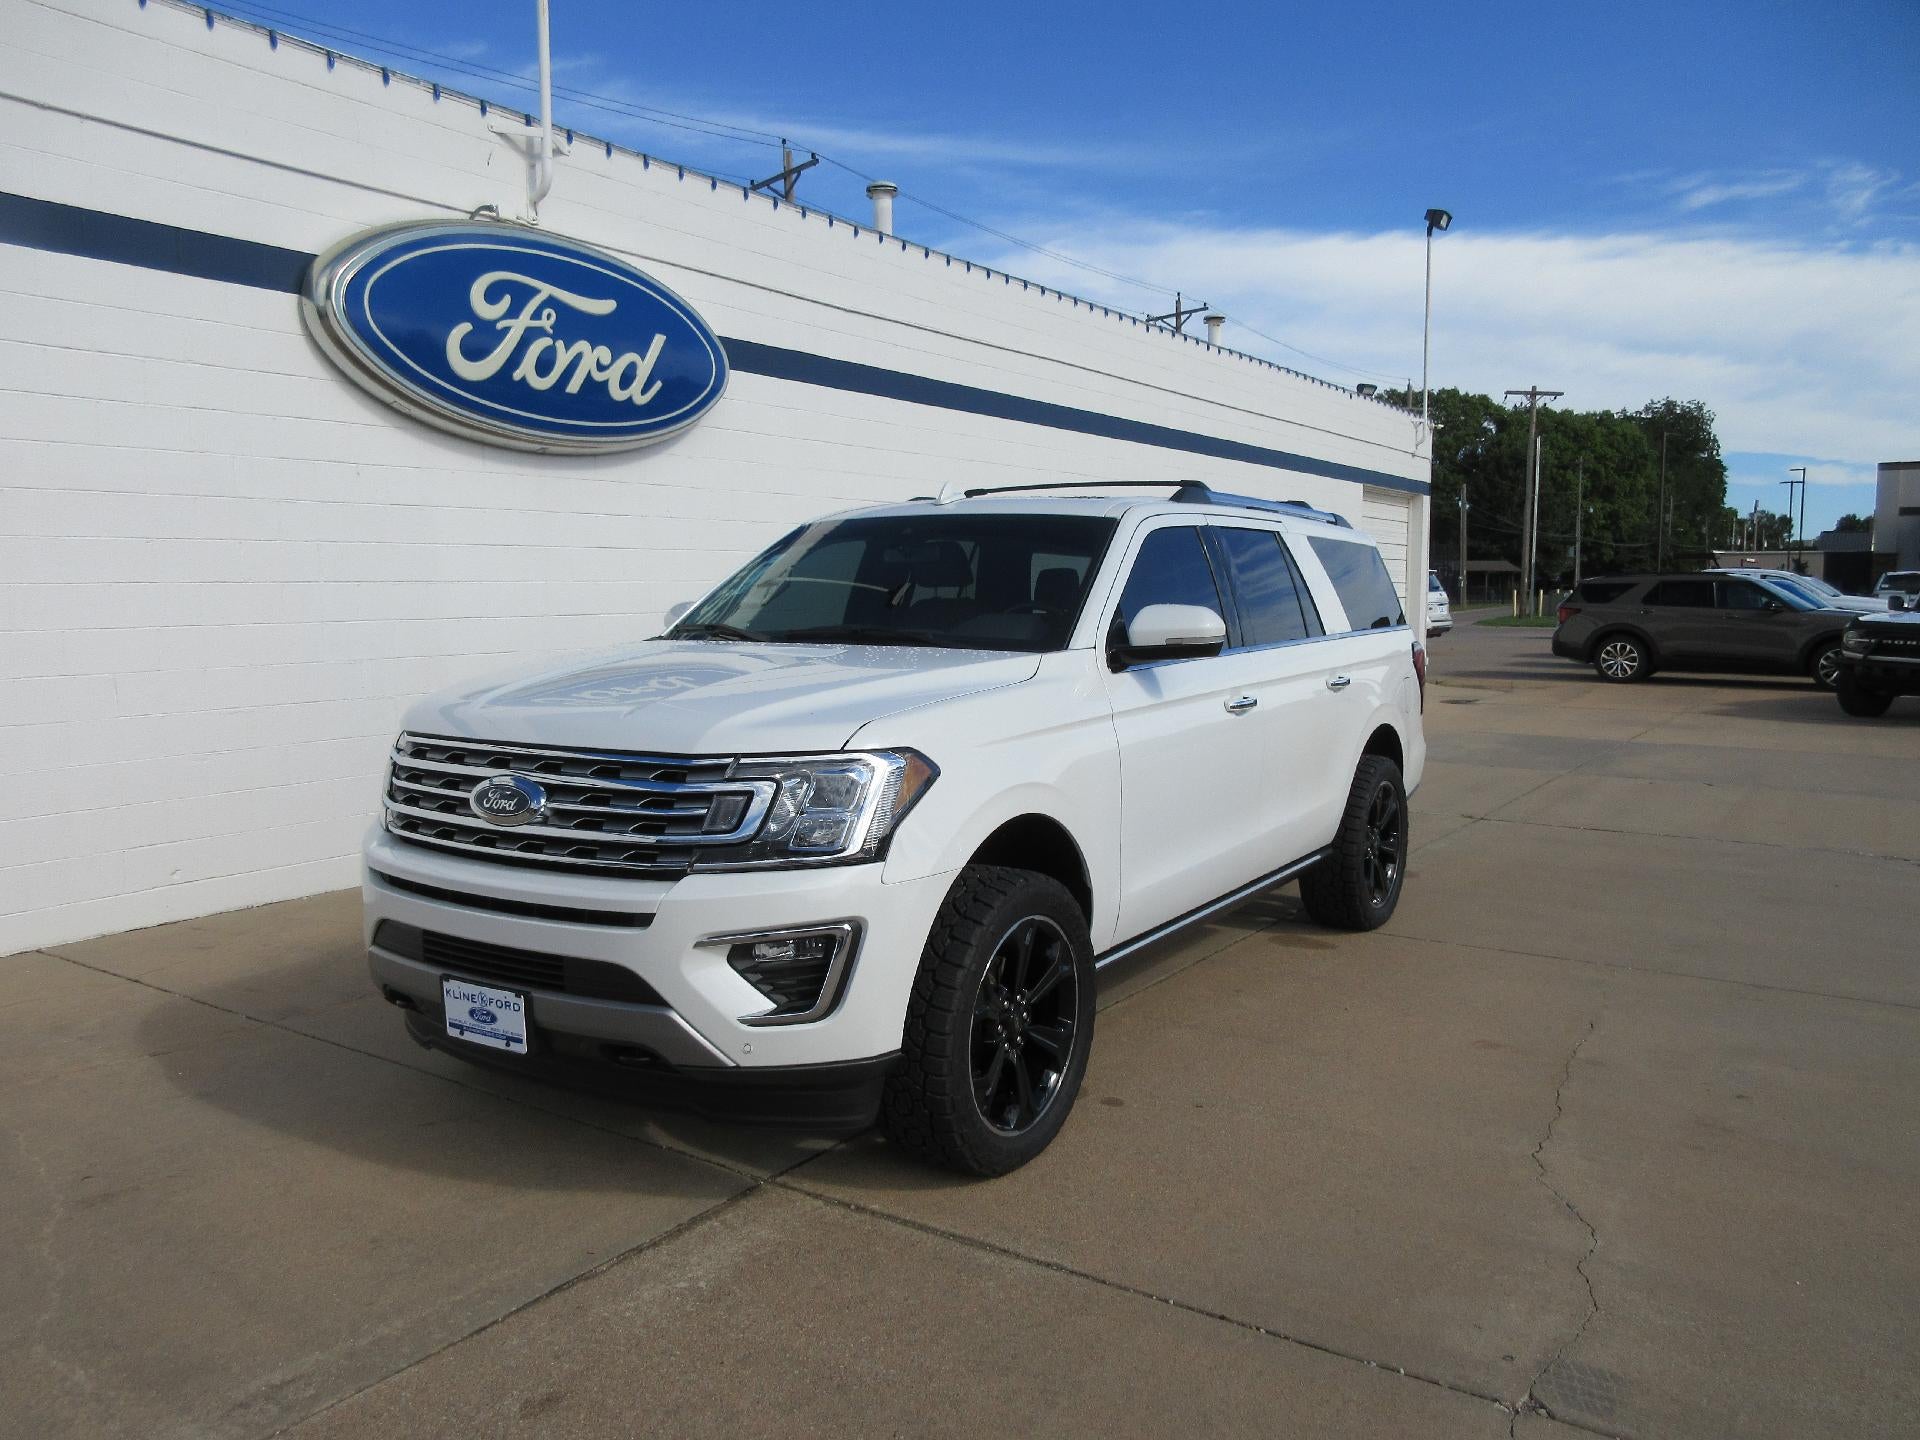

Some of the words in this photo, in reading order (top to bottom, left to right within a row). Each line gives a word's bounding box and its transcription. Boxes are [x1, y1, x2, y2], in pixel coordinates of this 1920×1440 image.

[446, 271, 667, 406] Ford
[483, 788, 519, 811] Ford
[445, 987, 478, 1004] KLINE
[488, 999, 521, 1012] FORD
[473, 1009, 491, 1022] Ford
